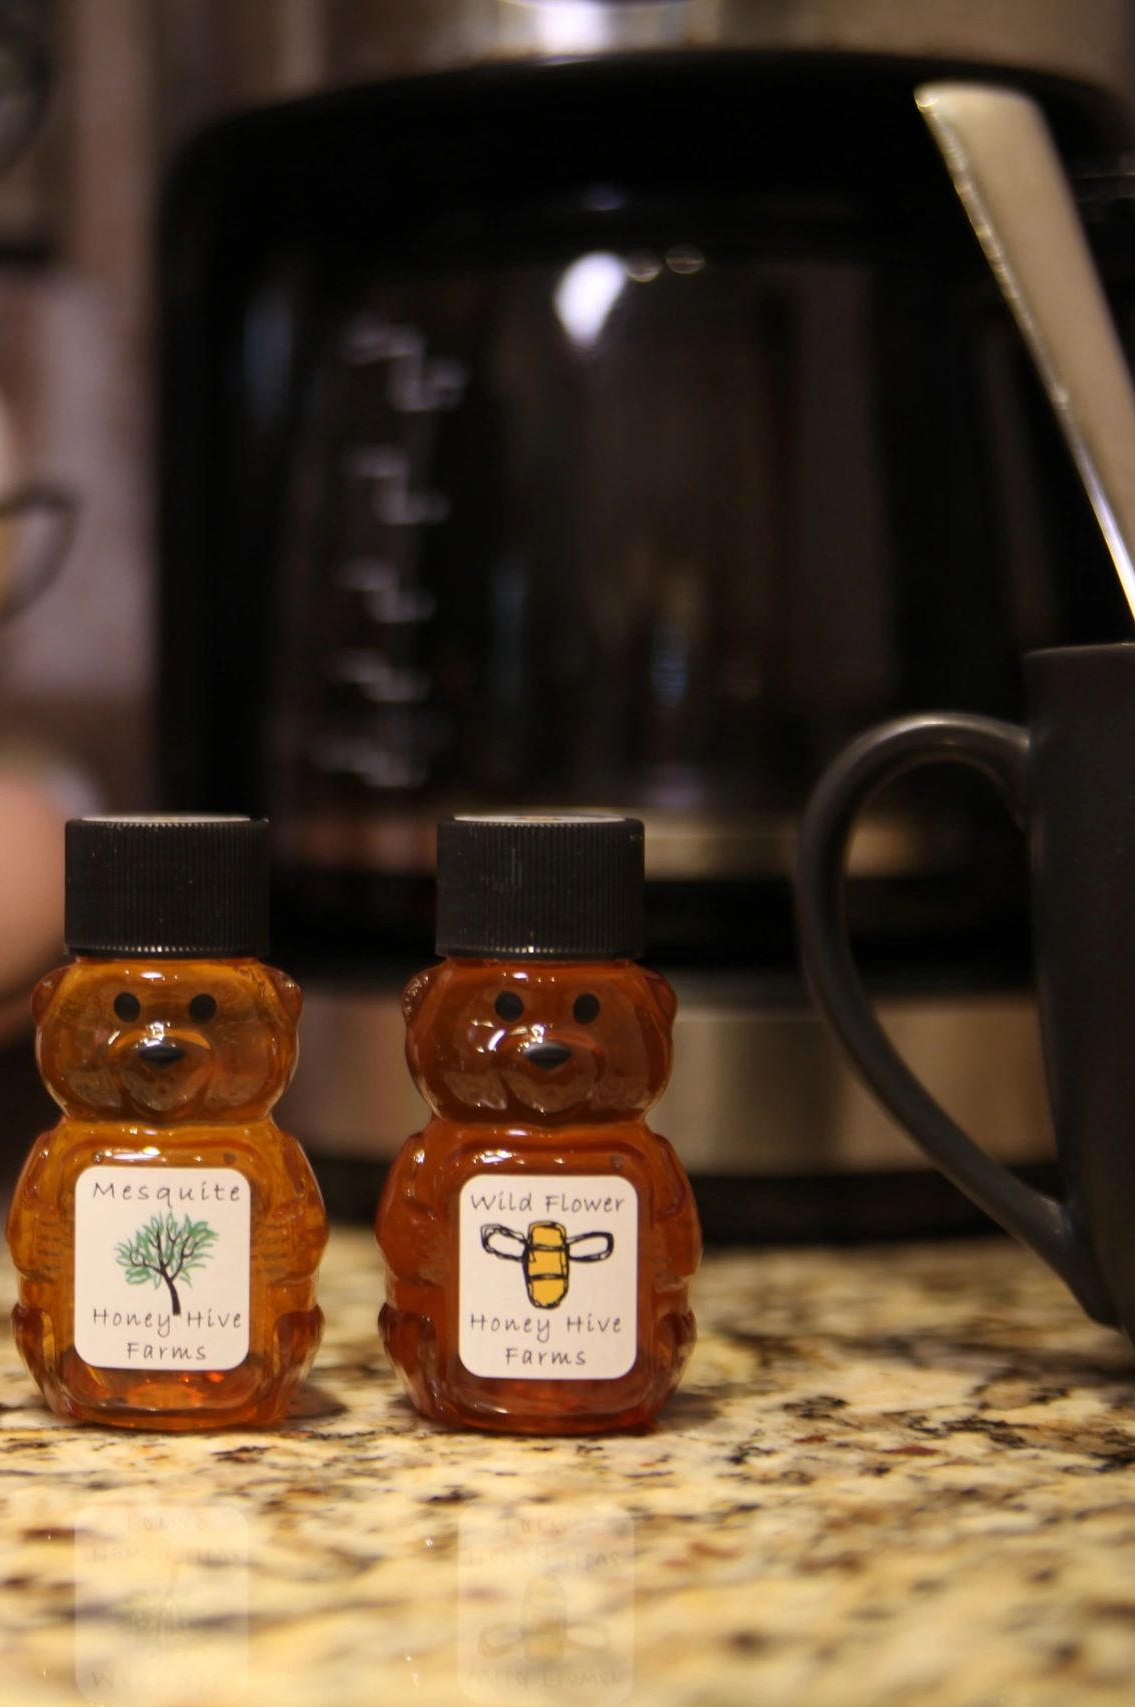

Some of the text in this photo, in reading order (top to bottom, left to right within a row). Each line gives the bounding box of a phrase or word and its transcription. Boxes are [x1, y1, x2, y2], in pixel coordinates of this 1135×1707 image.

[93, 1181, 241, 1208] Mesquite
[471, 1192, 625, 1213] Wild Flower
[93, 1308, 242, 1337] Honey Hive
[470, 1313, 622, 1343] Honey Hive
[127, 1342, 206, 1360] Farms
[505, 1348, 586, 1366] Farms
